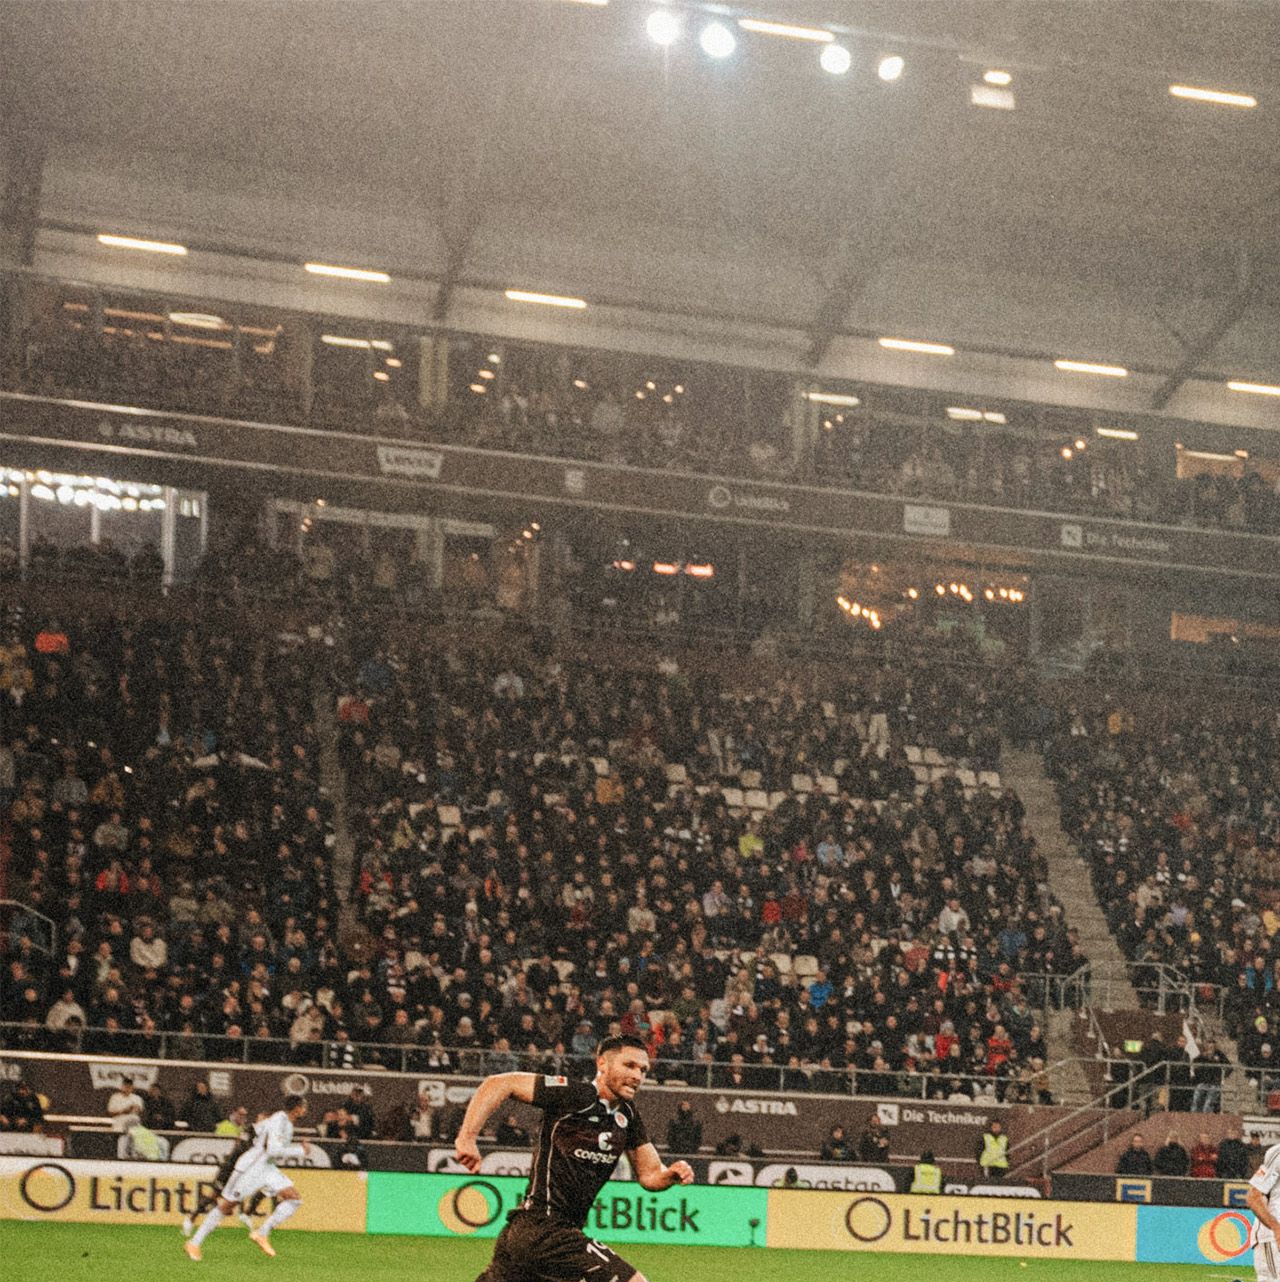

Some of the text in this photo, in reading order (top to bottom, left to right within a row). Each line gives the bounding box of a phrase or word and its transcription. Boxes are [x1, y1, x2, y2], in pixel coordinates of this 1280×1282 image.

[731, 1099, 798, 1116] ASTRA
[903, 1109, 988, 1127] Die Techniker
[903, 1209, 1074, 1249] LichtBlick
